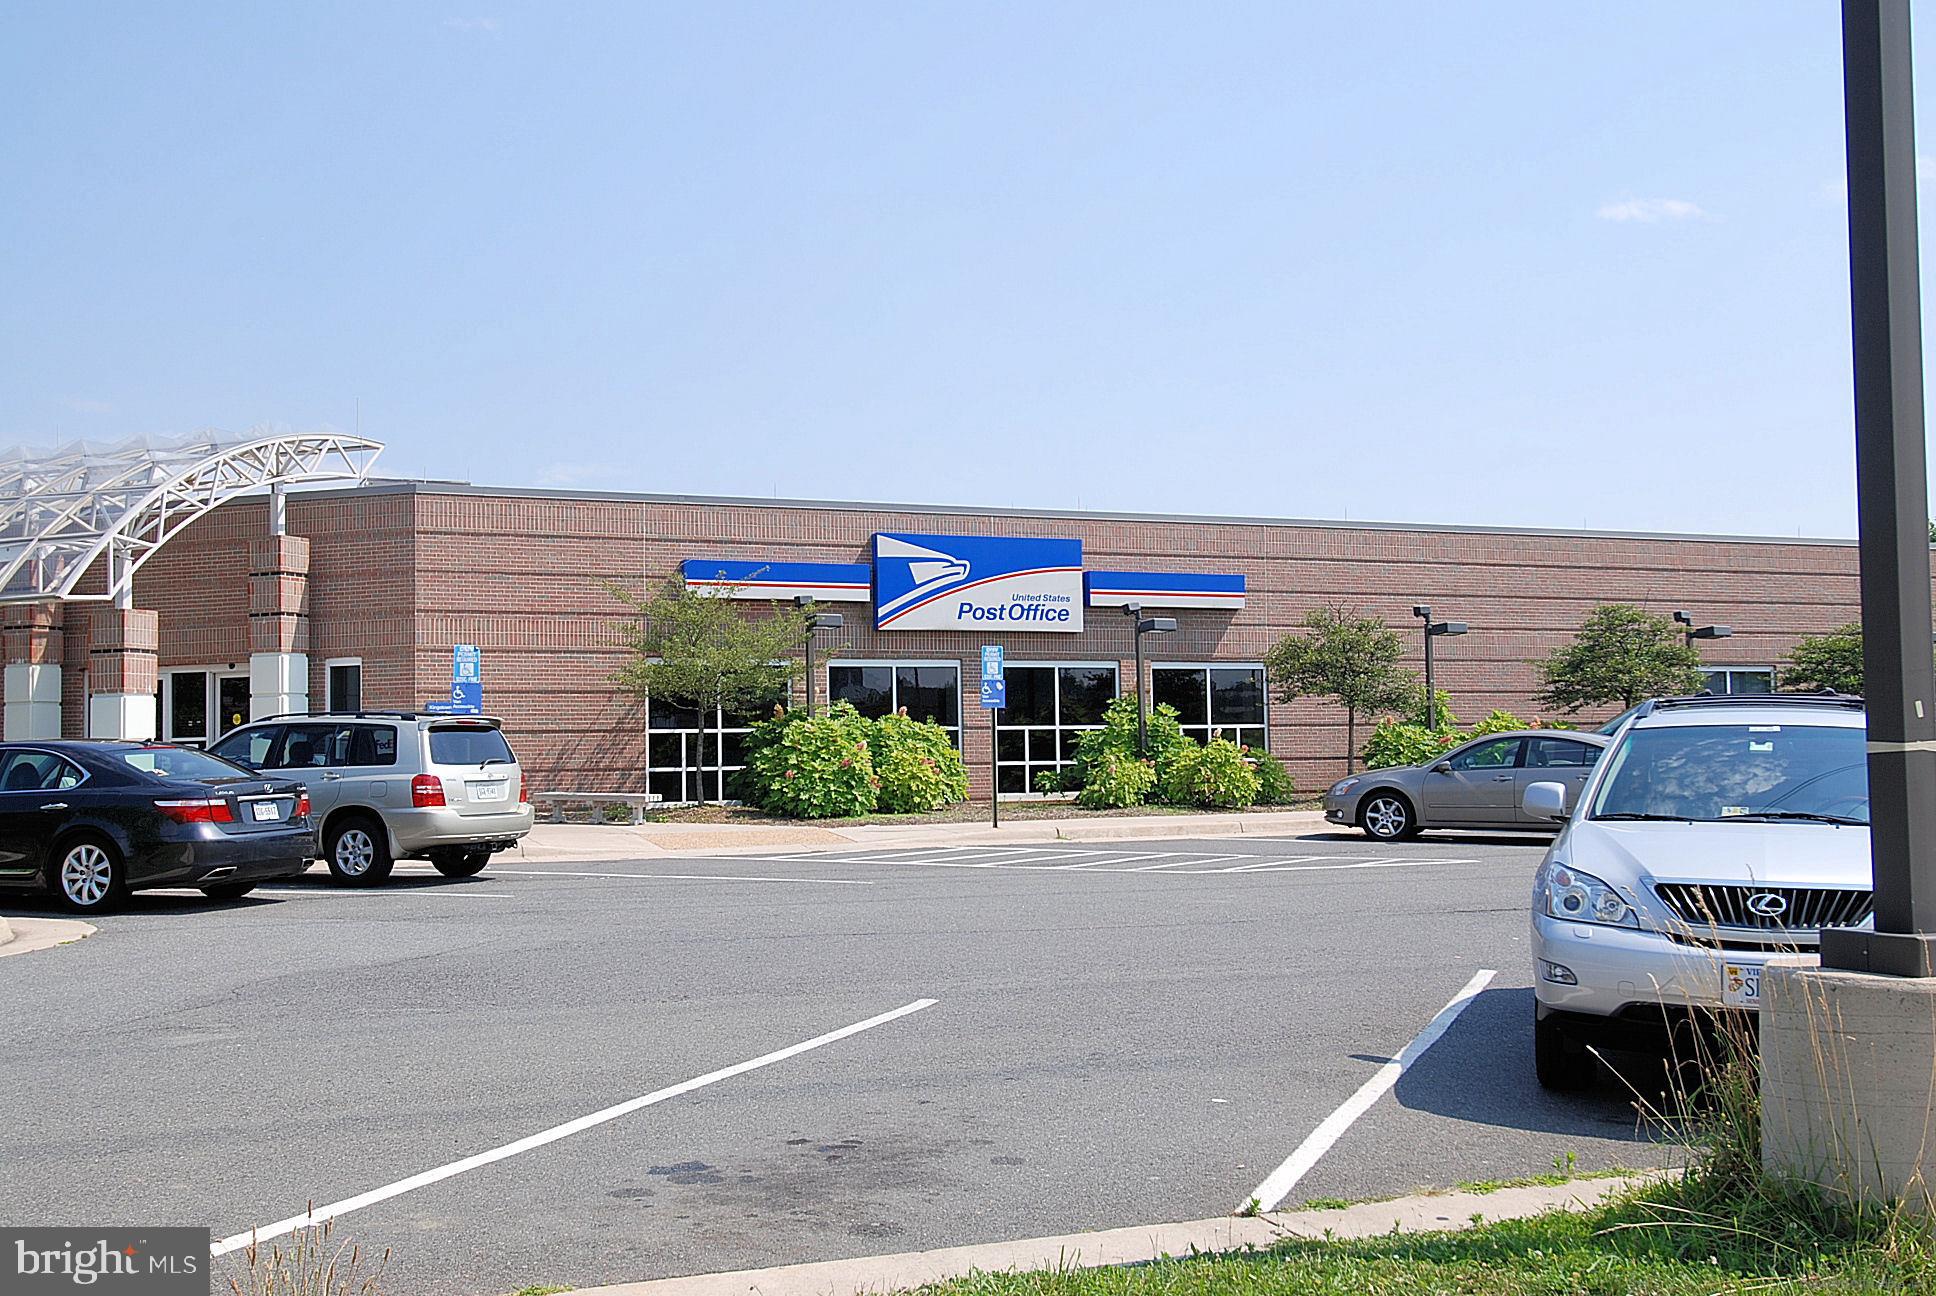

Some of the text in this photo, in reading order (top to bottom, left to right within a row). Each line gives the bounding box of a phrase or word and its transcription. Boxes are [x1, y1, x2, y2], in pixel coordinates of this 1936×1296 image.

[1011, 593, 1071, 602] United States
[957, 602, 1070, 621] Post Office
